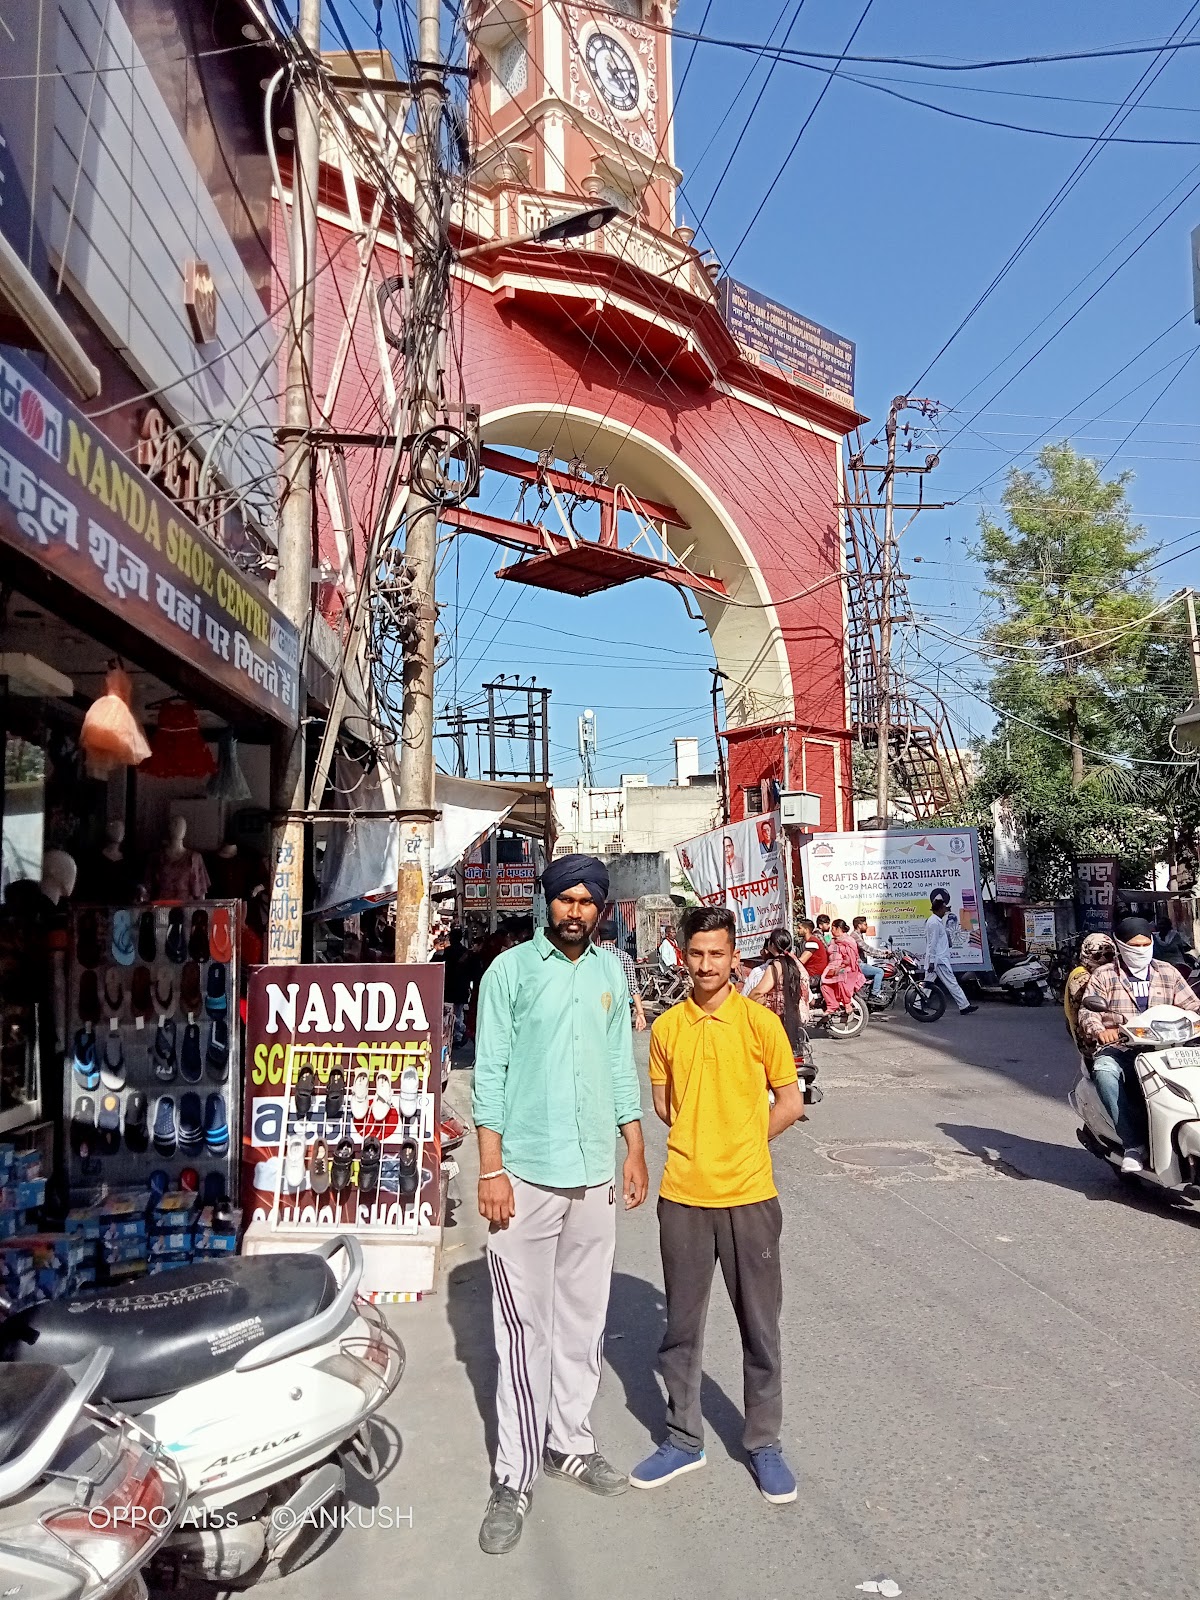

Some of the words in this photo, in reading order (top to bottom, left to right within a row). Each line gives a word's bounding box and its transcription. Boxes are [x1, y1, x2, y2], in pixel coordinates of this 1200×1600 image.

[67, 419, 162, 551] NANDA
[166, 518, 214, 597] SHOE
[217, 568, 269, 646] CENTRE
[88, 518, 149, 600] शूज
[156, 573, 201, 639] यहां
[205, 613, 230, 661] पर
[234, 631, 279, 697] मिलते
[822, 872, 858, 882] CRAFTS
[861, 870, 899, 881] BAZAAR
[901, 869, 961, 879] HOSHIARPUR
[835, 883, 859, 891] 20-29
[265, 982, 430, 1034] NANDA
[252, 1042, 346, 1085] SCHOOL
[356, 1041, 432, 1083] SHOES
[134, 1302, 167, 1311] Power
[187, 1288, 230, 1303] Dreams
[228, 1315, 262, 1336] HONDA
[202, 1431, 302, 1473] Activa
